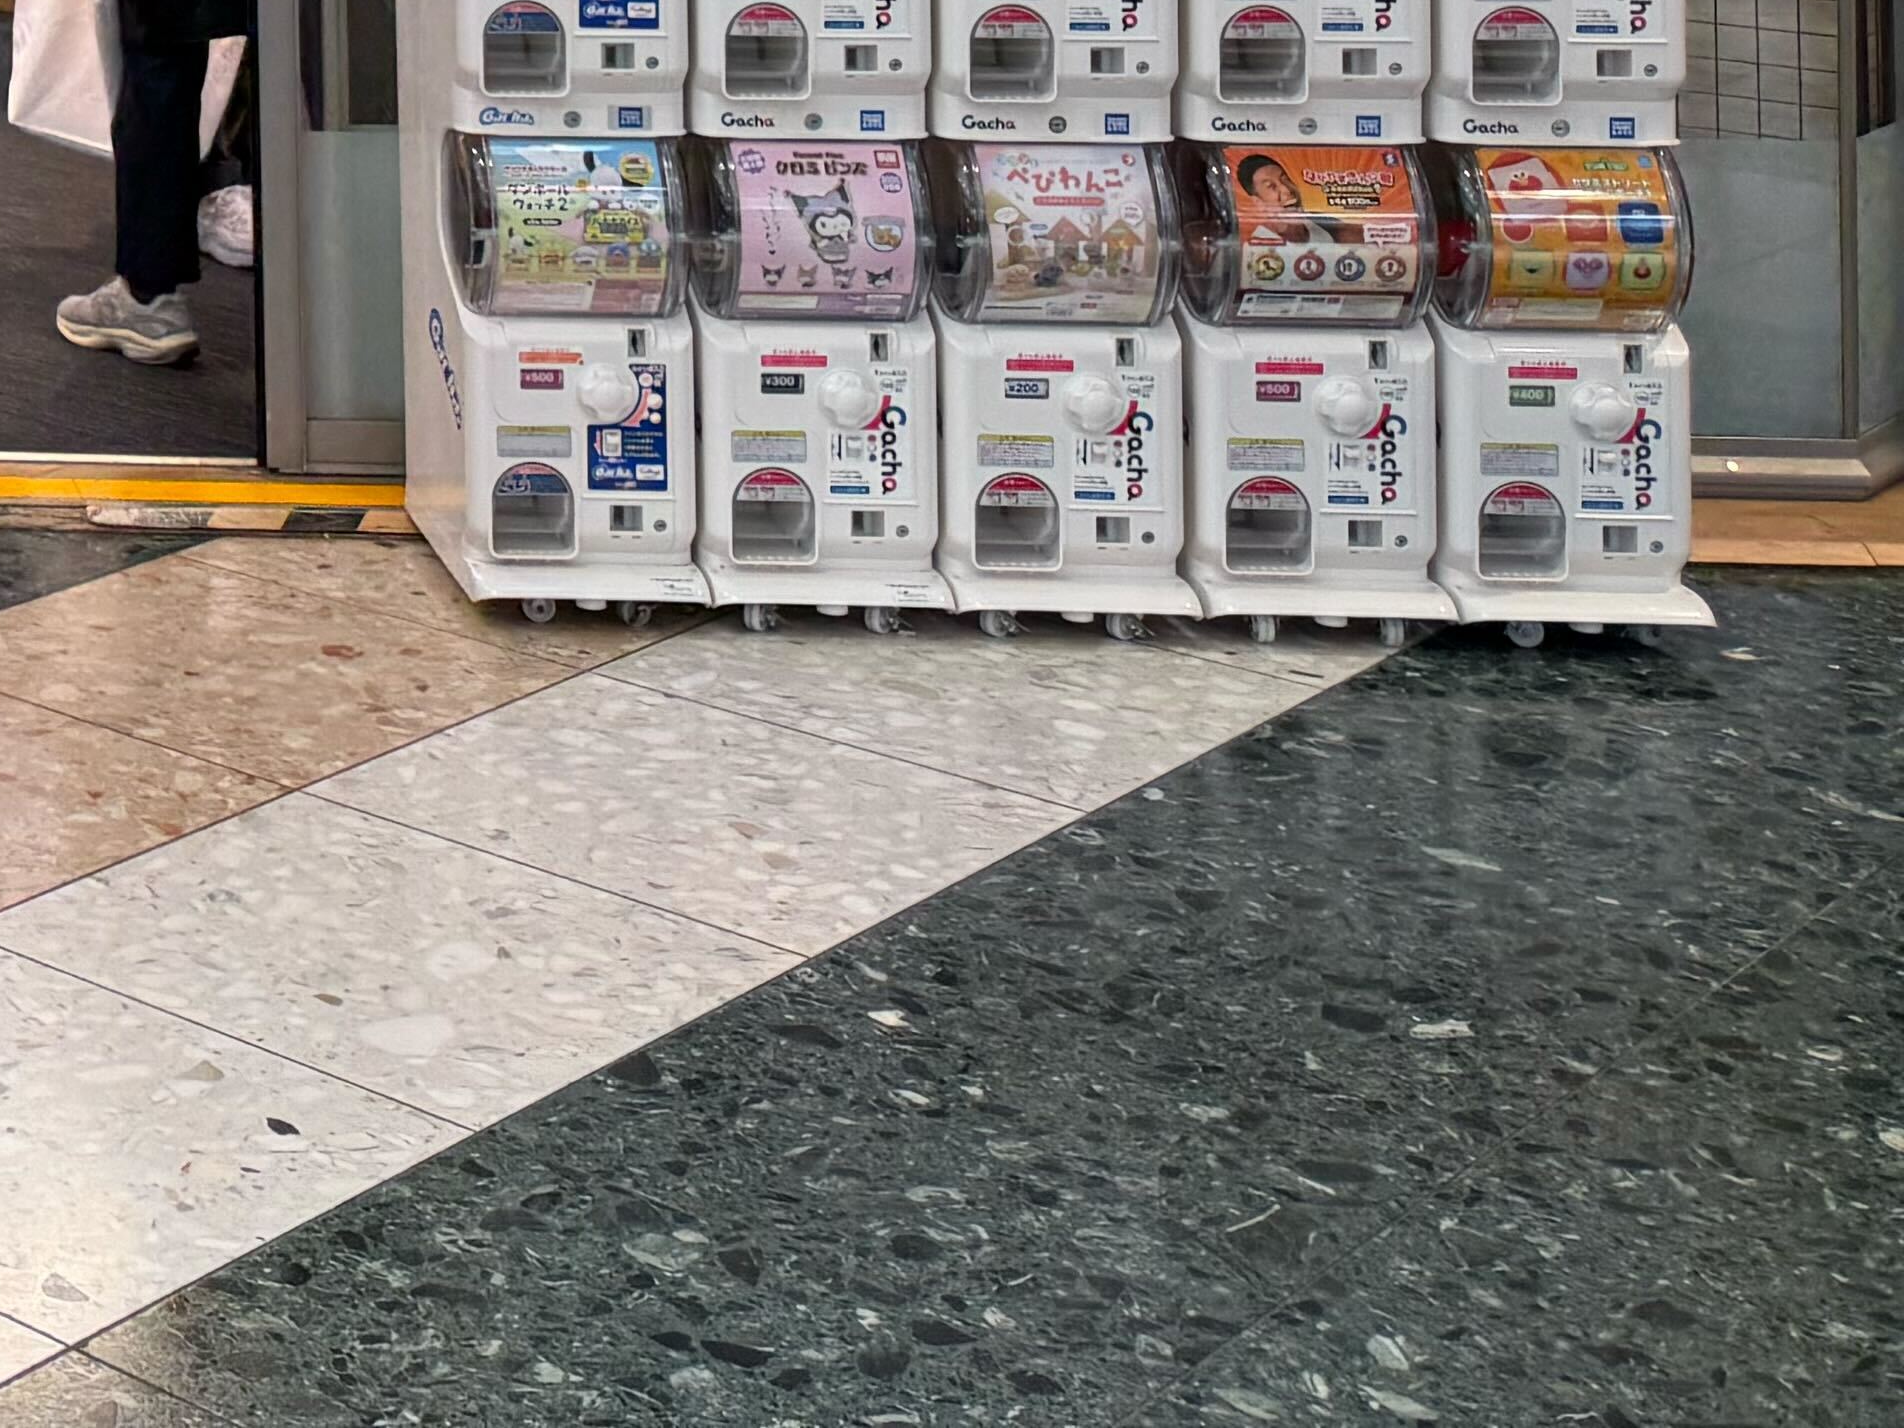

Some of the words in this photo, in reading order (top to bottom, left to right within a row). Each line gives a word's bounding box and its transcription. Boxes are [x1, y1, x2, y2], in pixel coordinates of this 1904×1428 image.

[721, 111, 775, 130] Gacha
[962, 114, 1016, 132] Gacha
[1212, 116, 1267, 134] Gacha
[1463, 118, 1519, 136] Gacha
[880, 405, 907, 496] Gacha
[1126, 412, 1154, 503] Gacha
[1379, 414, 1408, 505] Gacha
[1633, 419, 1663, 511] Gacha
